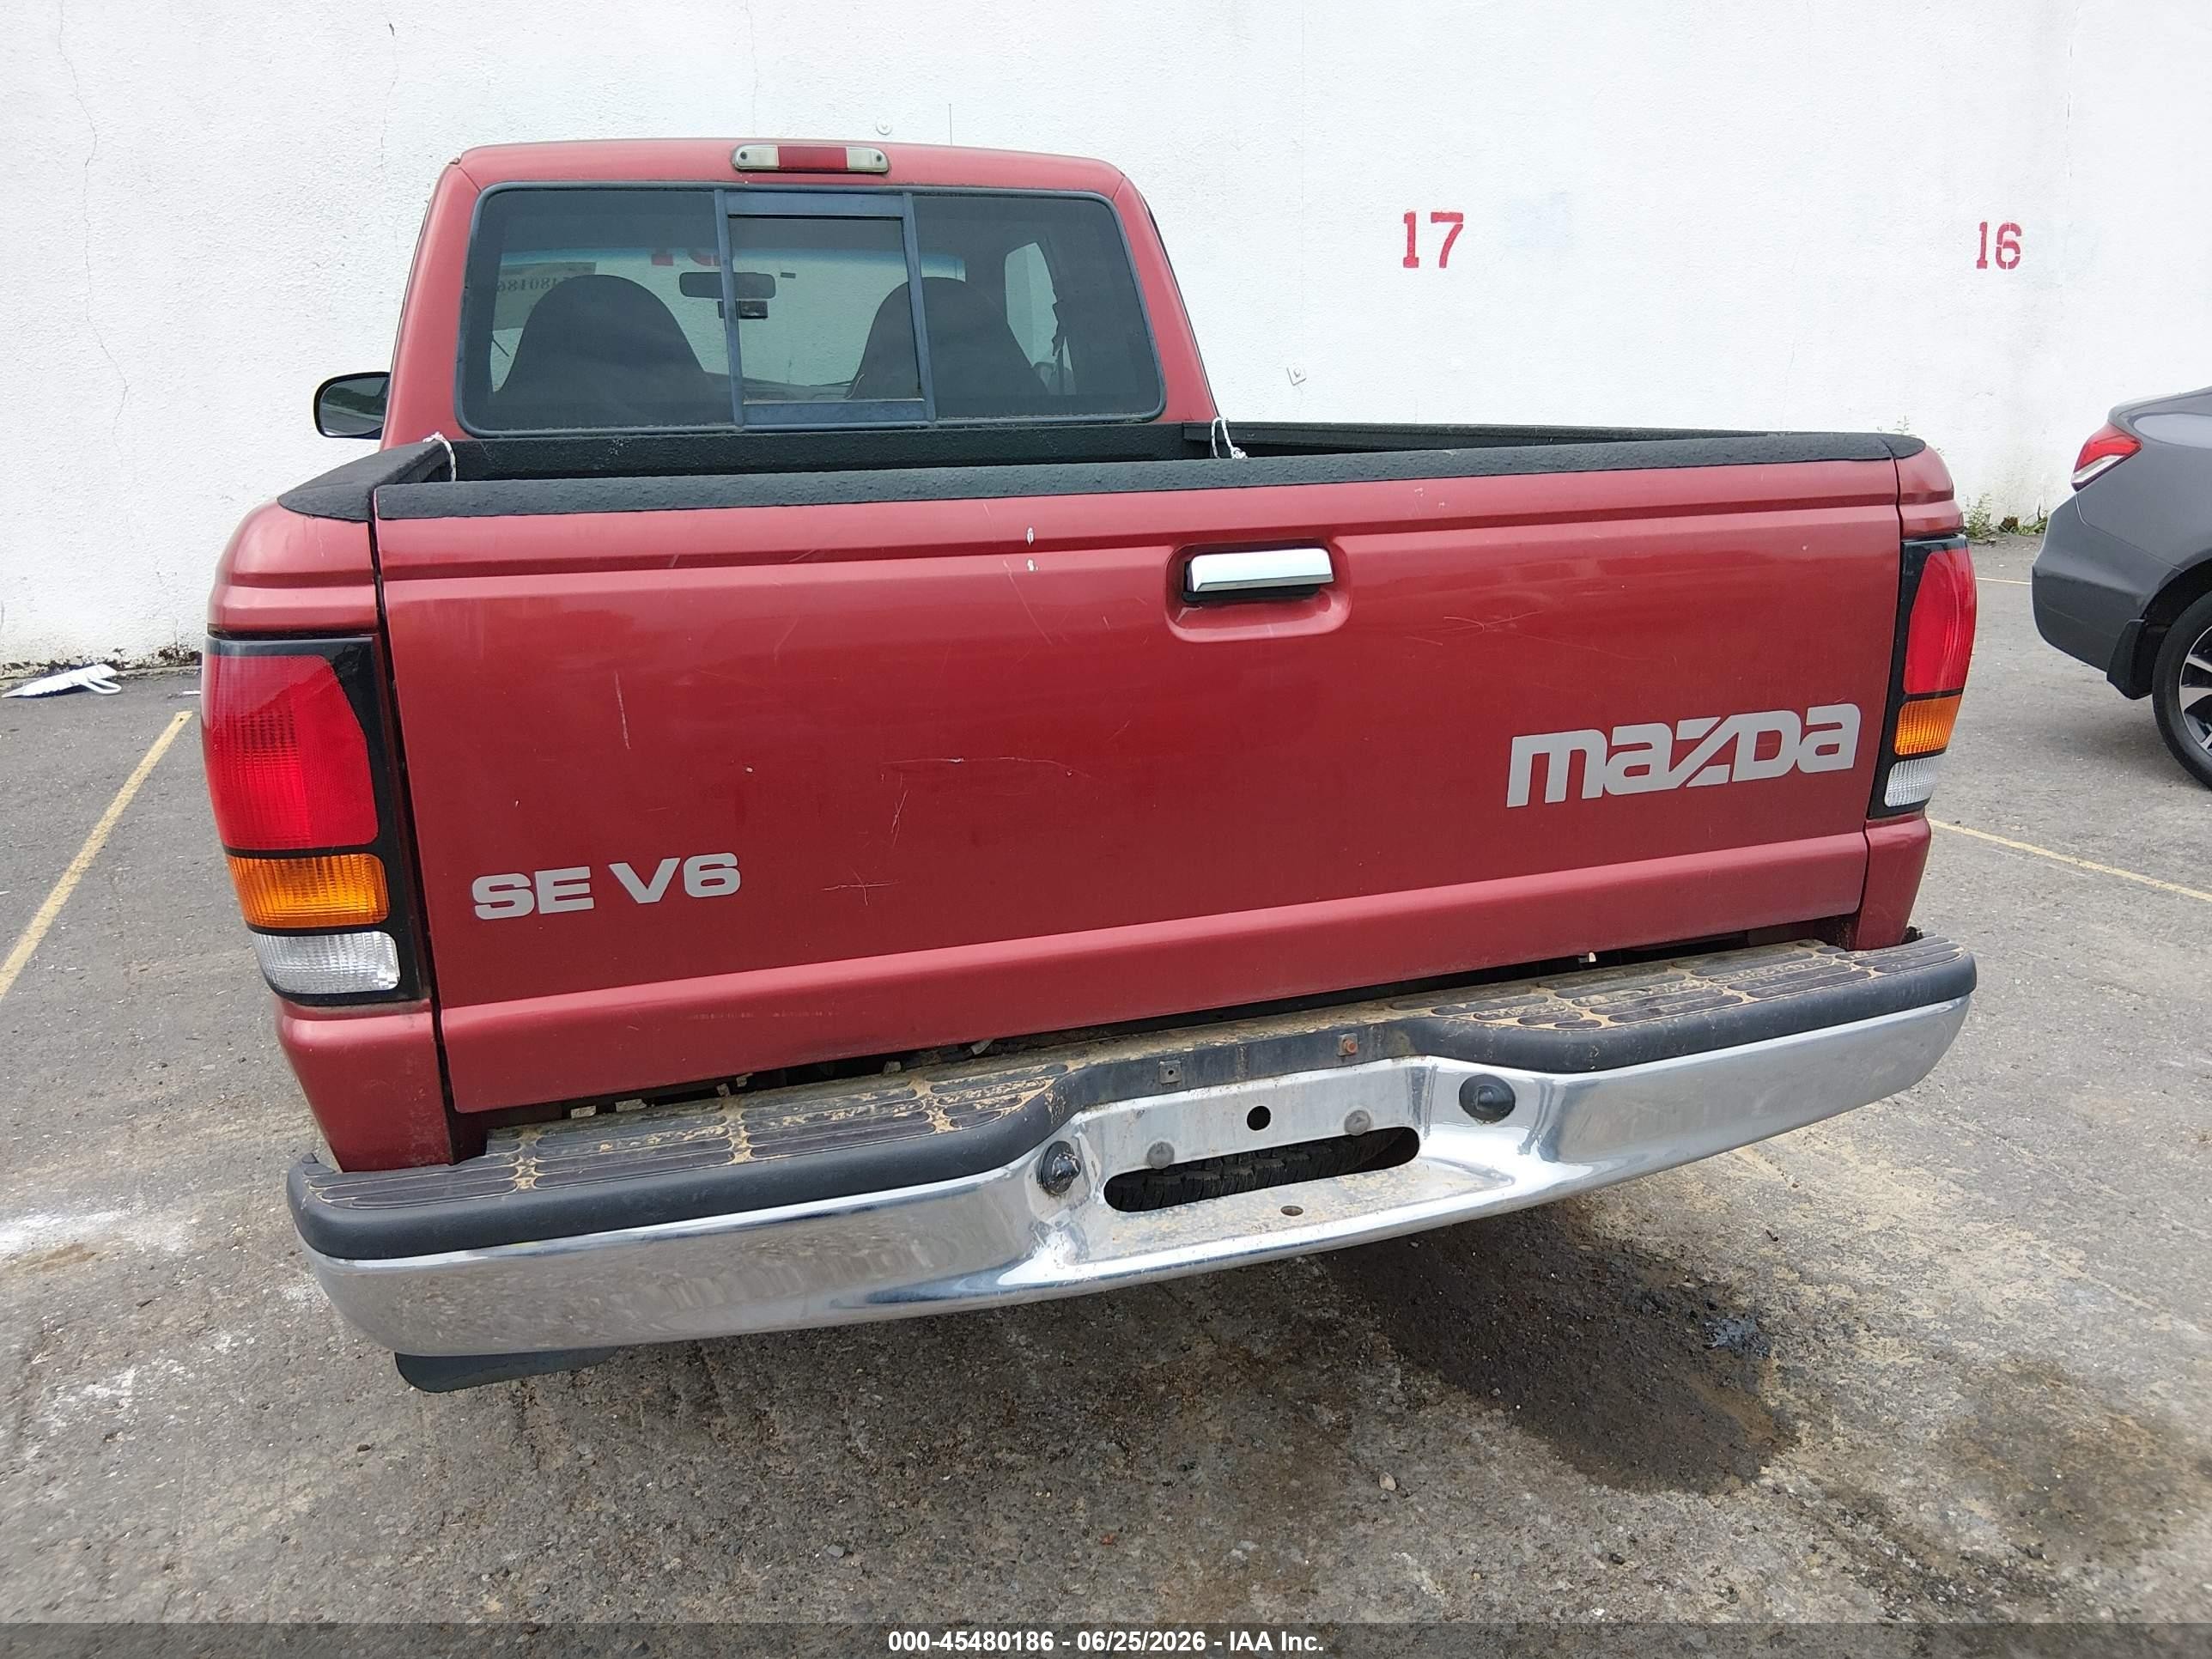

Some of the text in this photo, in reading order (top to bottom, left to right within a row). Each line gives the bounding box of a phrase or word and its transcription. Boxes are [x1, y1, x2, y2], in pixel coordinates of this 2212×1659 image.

[1402, 211, 1464, 269] 17
[1977, 222, 2021, 270] 16
[471, 852, 742, 921] SE V6
